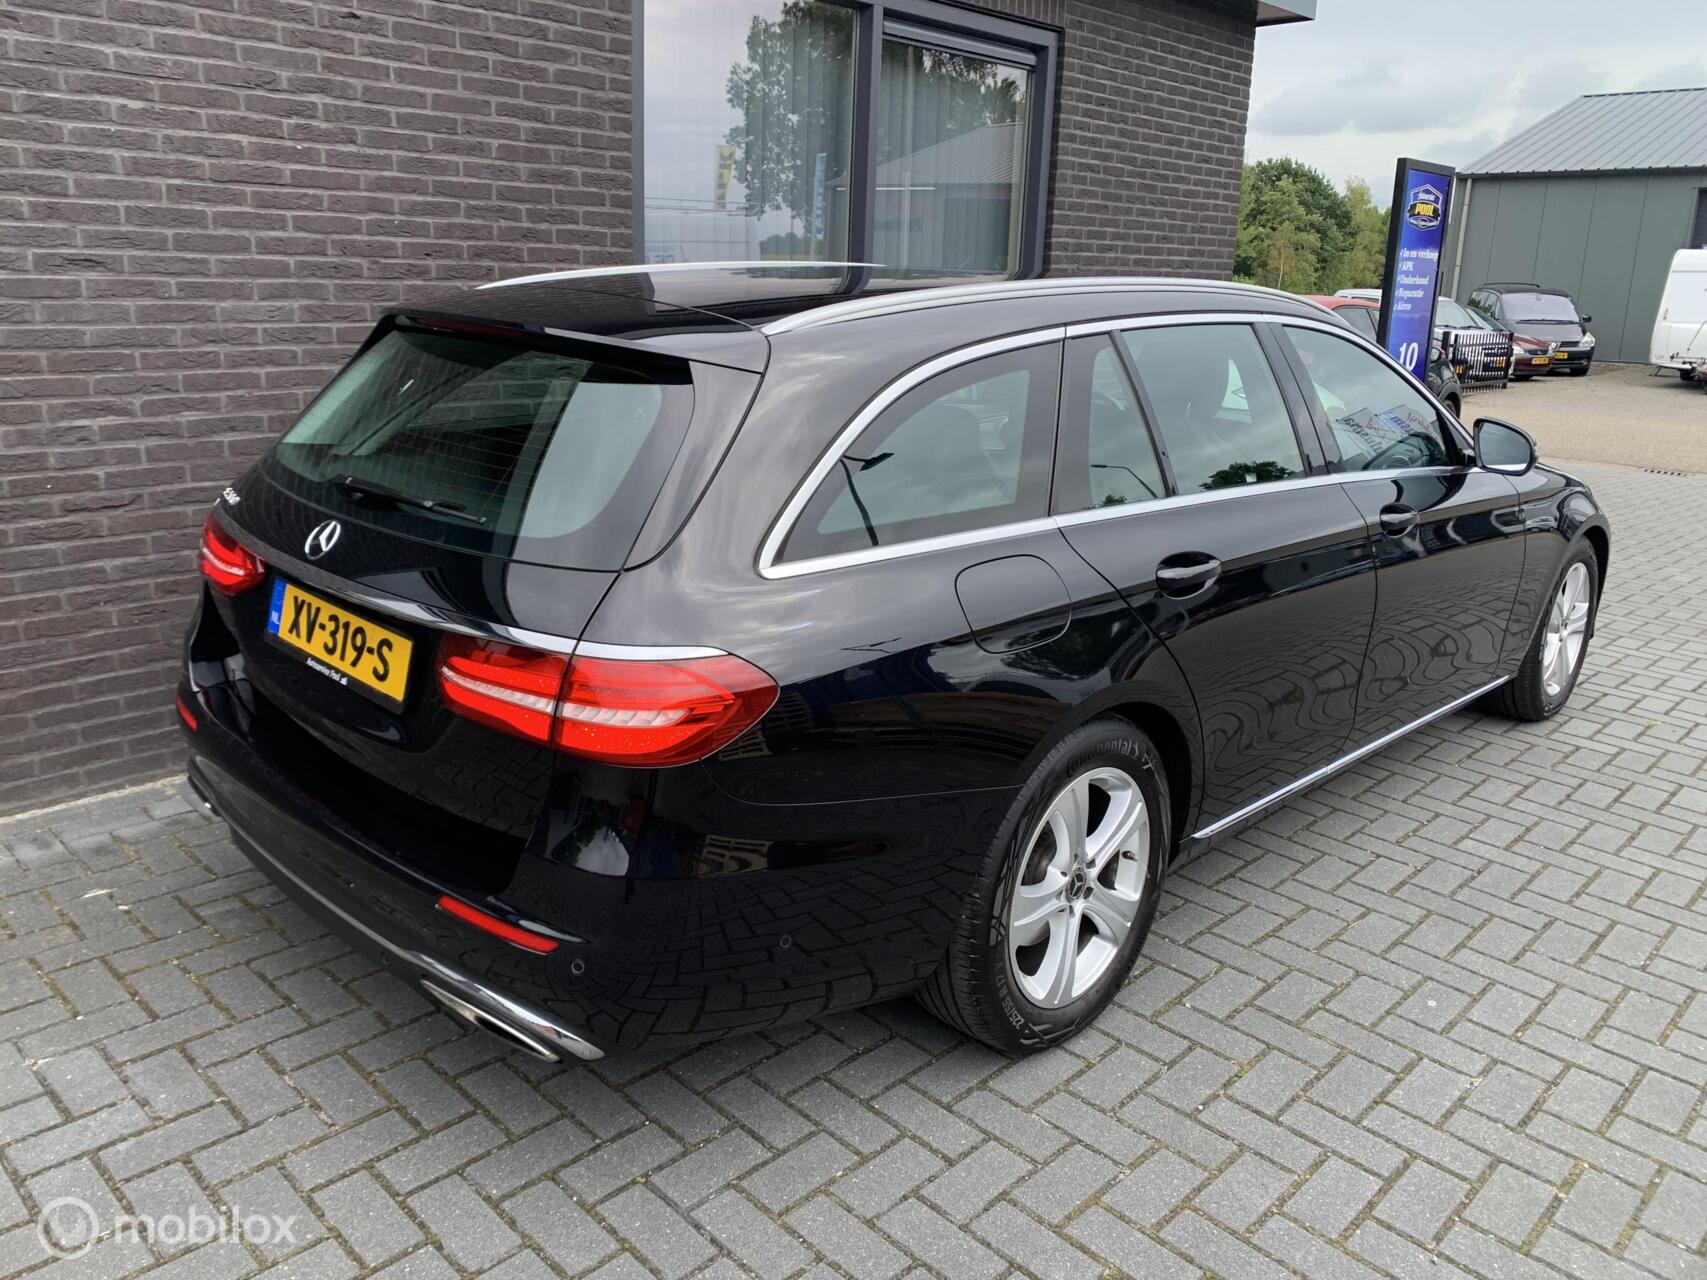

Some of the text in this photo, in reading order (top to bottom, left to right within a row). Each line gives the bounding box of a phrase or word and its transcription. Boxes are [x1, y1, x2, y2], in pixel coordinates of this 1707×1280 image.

[1415, 203, 1434, 216] POOL
[1402, 261, 1414, 271] APK
[1400, 274, 1430, 285] Onderhoud
[1399, 287, 1424, 300] Reparatie
[1399, 342, 1419, 370] 10
[287, 595, 394, 682] XV-319-S
